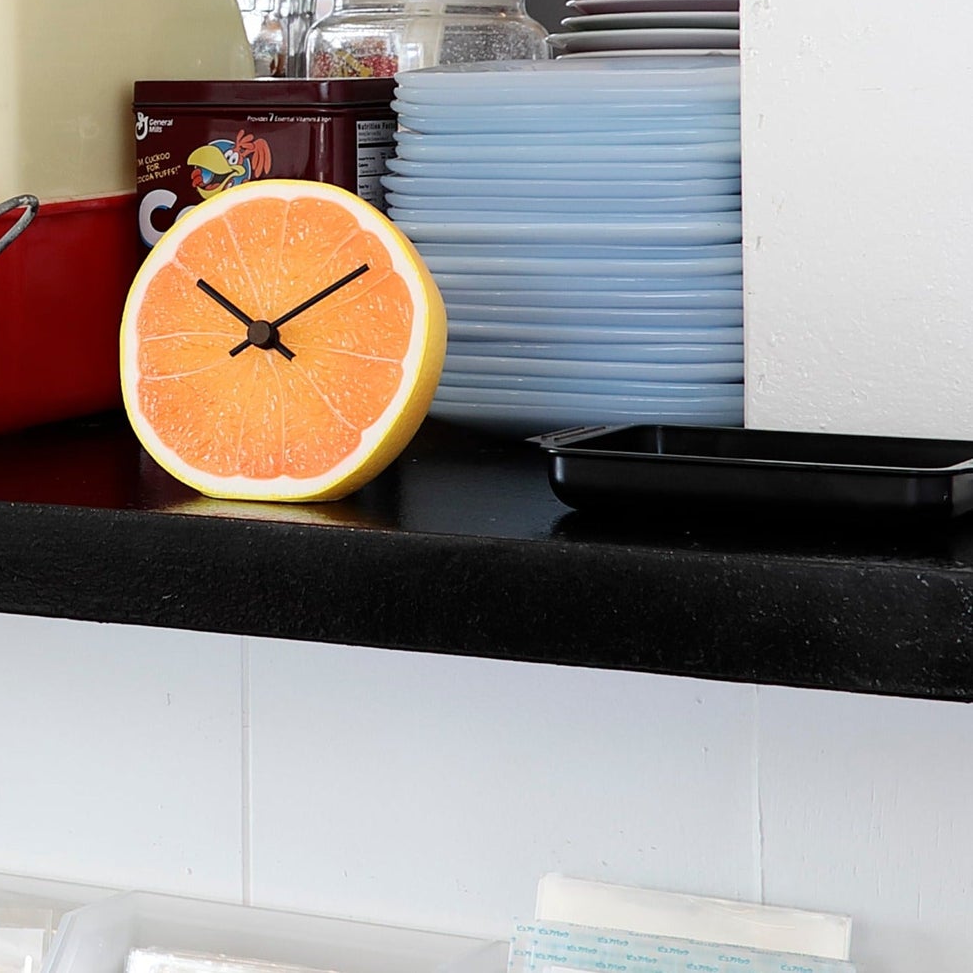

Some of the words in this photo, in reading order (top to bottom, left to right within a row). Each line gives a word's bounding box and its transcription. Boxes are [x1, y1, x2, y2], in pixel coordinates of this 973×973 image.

[268, 112, 274, 122] 7
[144, 152, 171, 165] CUCKOO
[146, 162, 161, 173] FOR
[139, 188, 198, 248] C
